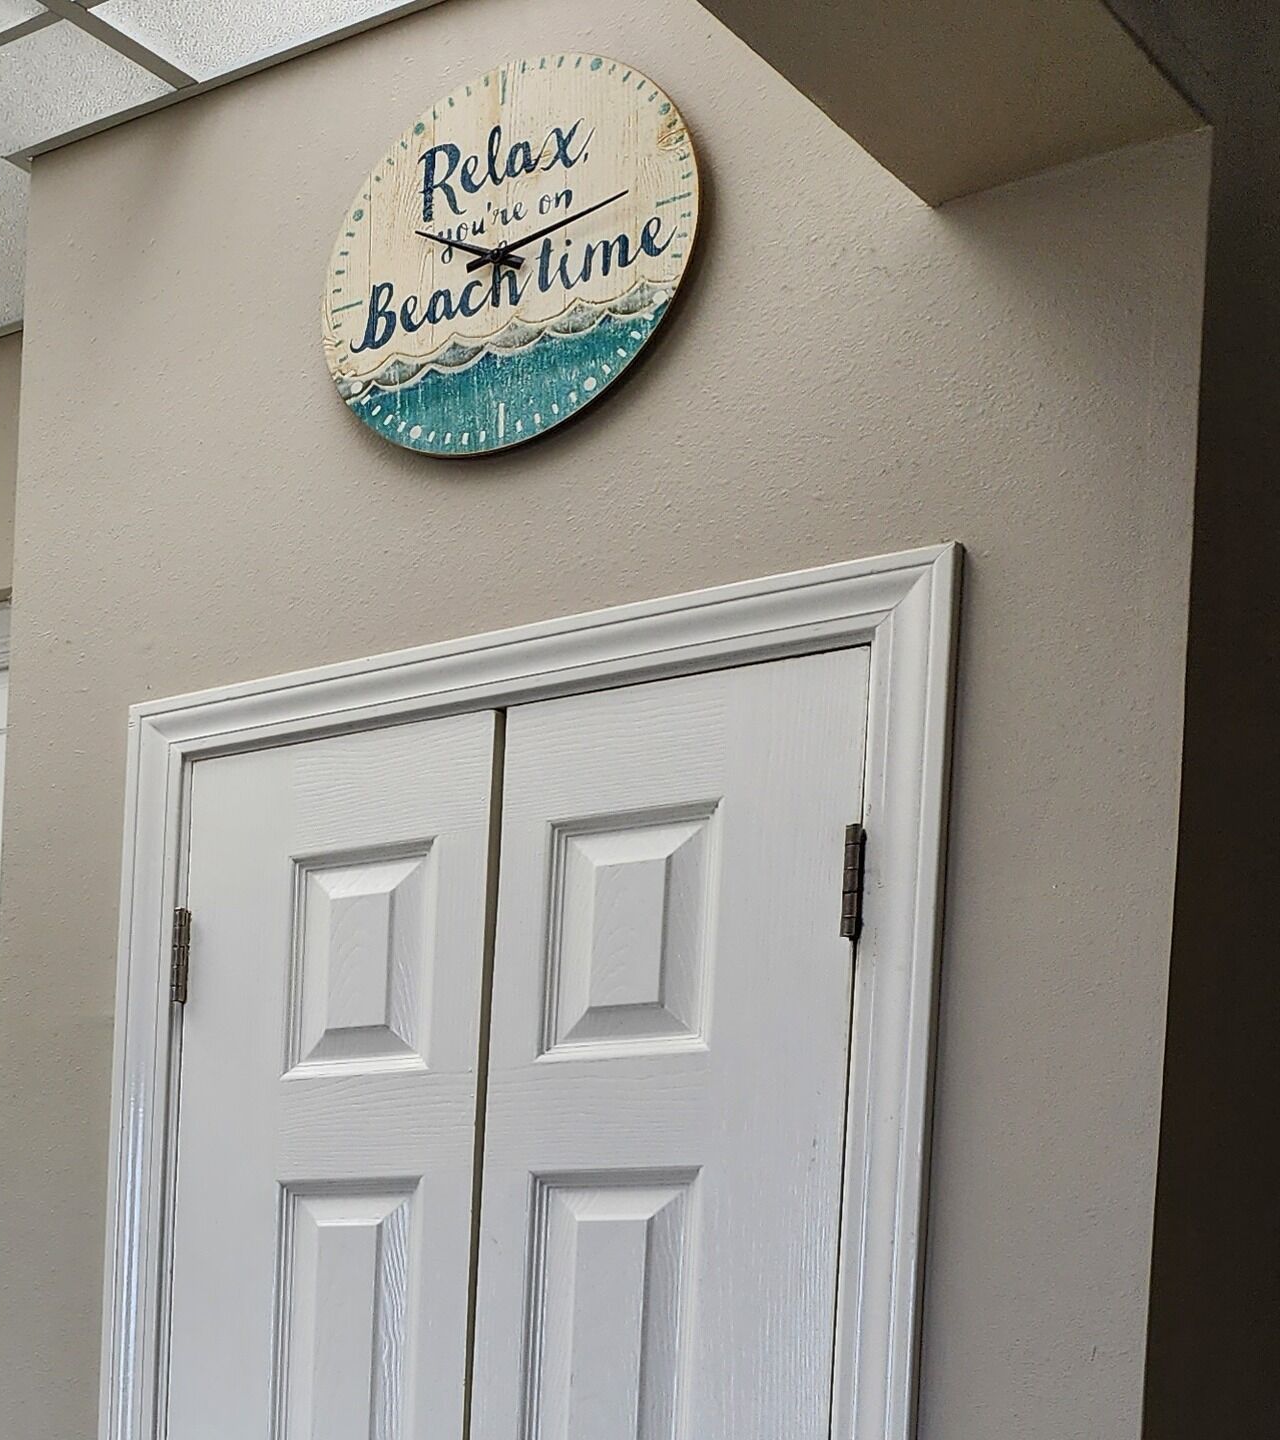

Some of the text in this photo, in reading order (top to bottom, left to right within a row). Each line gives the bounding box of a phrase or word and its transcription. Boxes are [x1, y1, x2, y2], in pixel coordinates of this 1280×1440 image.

[539, 188, 574, 216] on
[349, 216, 678, 353] Beach time
